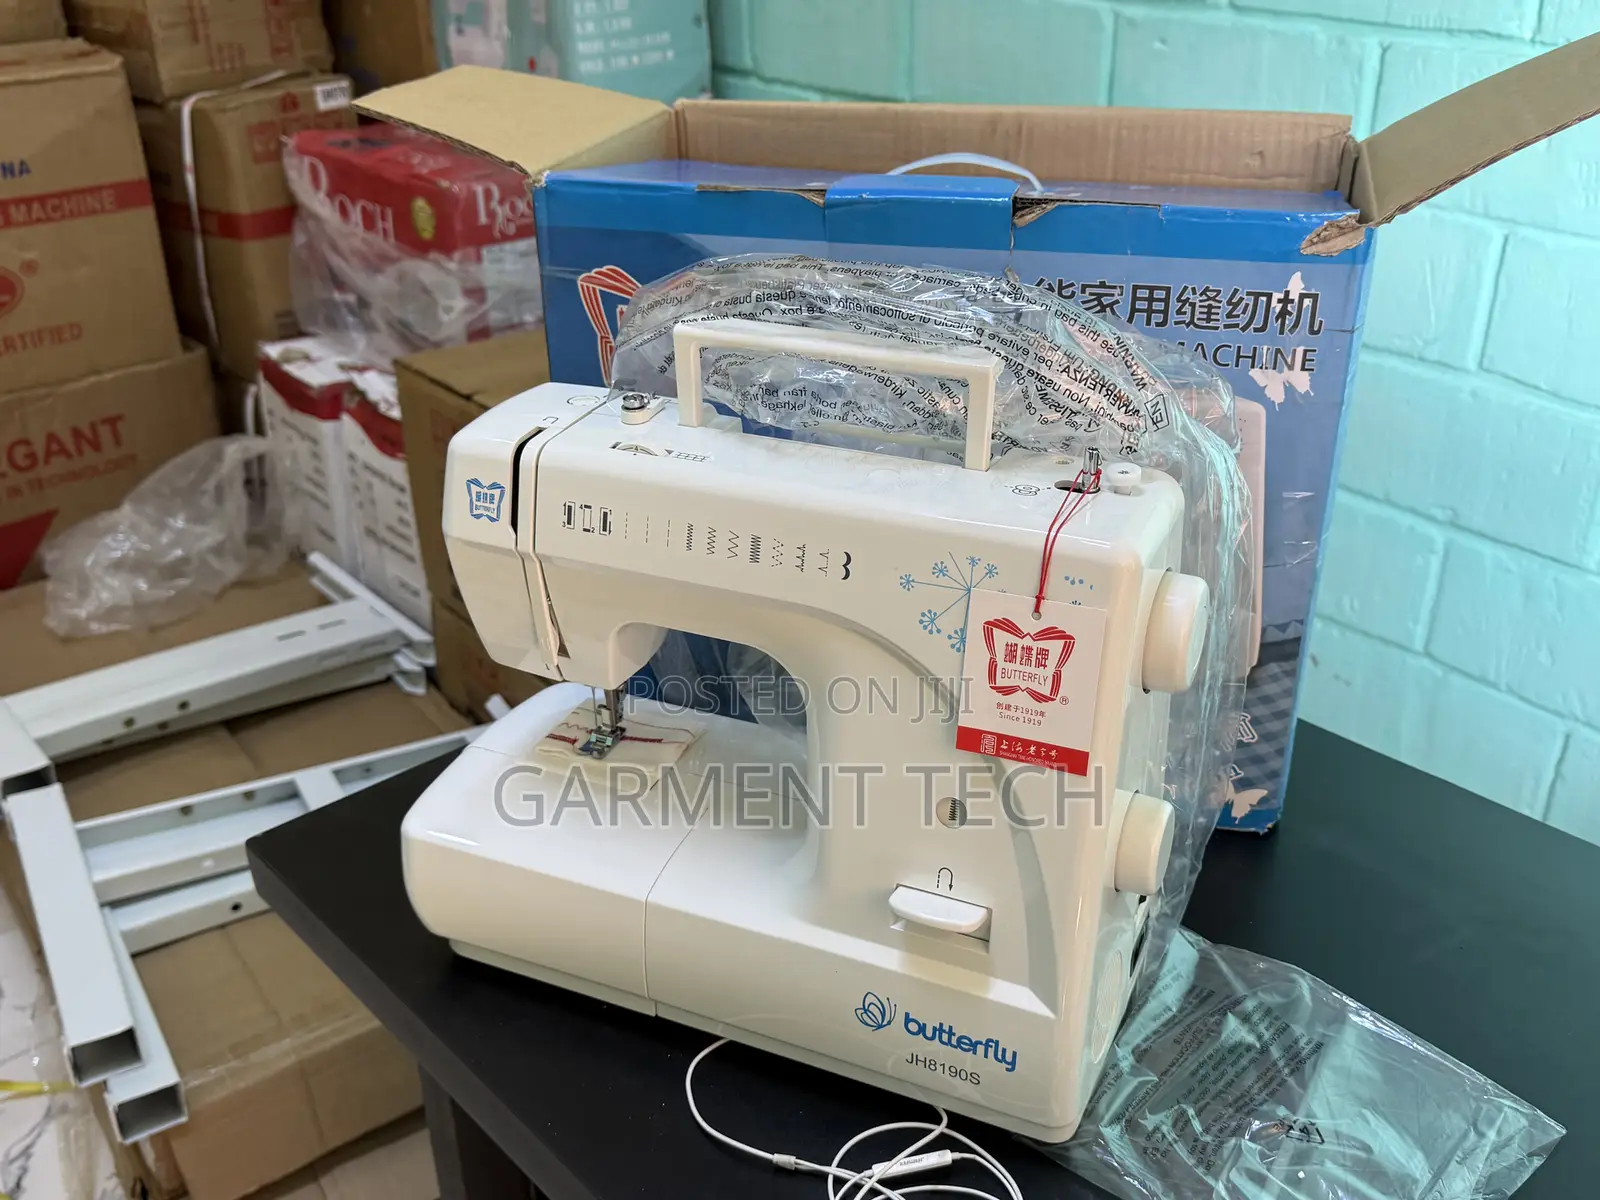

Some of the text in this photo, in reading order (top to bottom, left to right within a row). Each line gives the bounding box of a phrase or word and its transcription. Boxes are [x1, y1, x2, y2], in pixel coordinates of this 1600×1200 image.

[9, 188, 117, 223] MACHINE
[5, 412, 126, 473] GANT
[1003, 641, 1050, 670] 蝴蝶牌
[1000, 667, 1049, 687] BUTTERFLY
[996, 701, 1047, 718] 创建于1919年
[998, 711, 1042, 727] Since 1919
[903, 1011, 1018, 1073] butterfly
[905, 1052, 981, 1085] JH8190S
